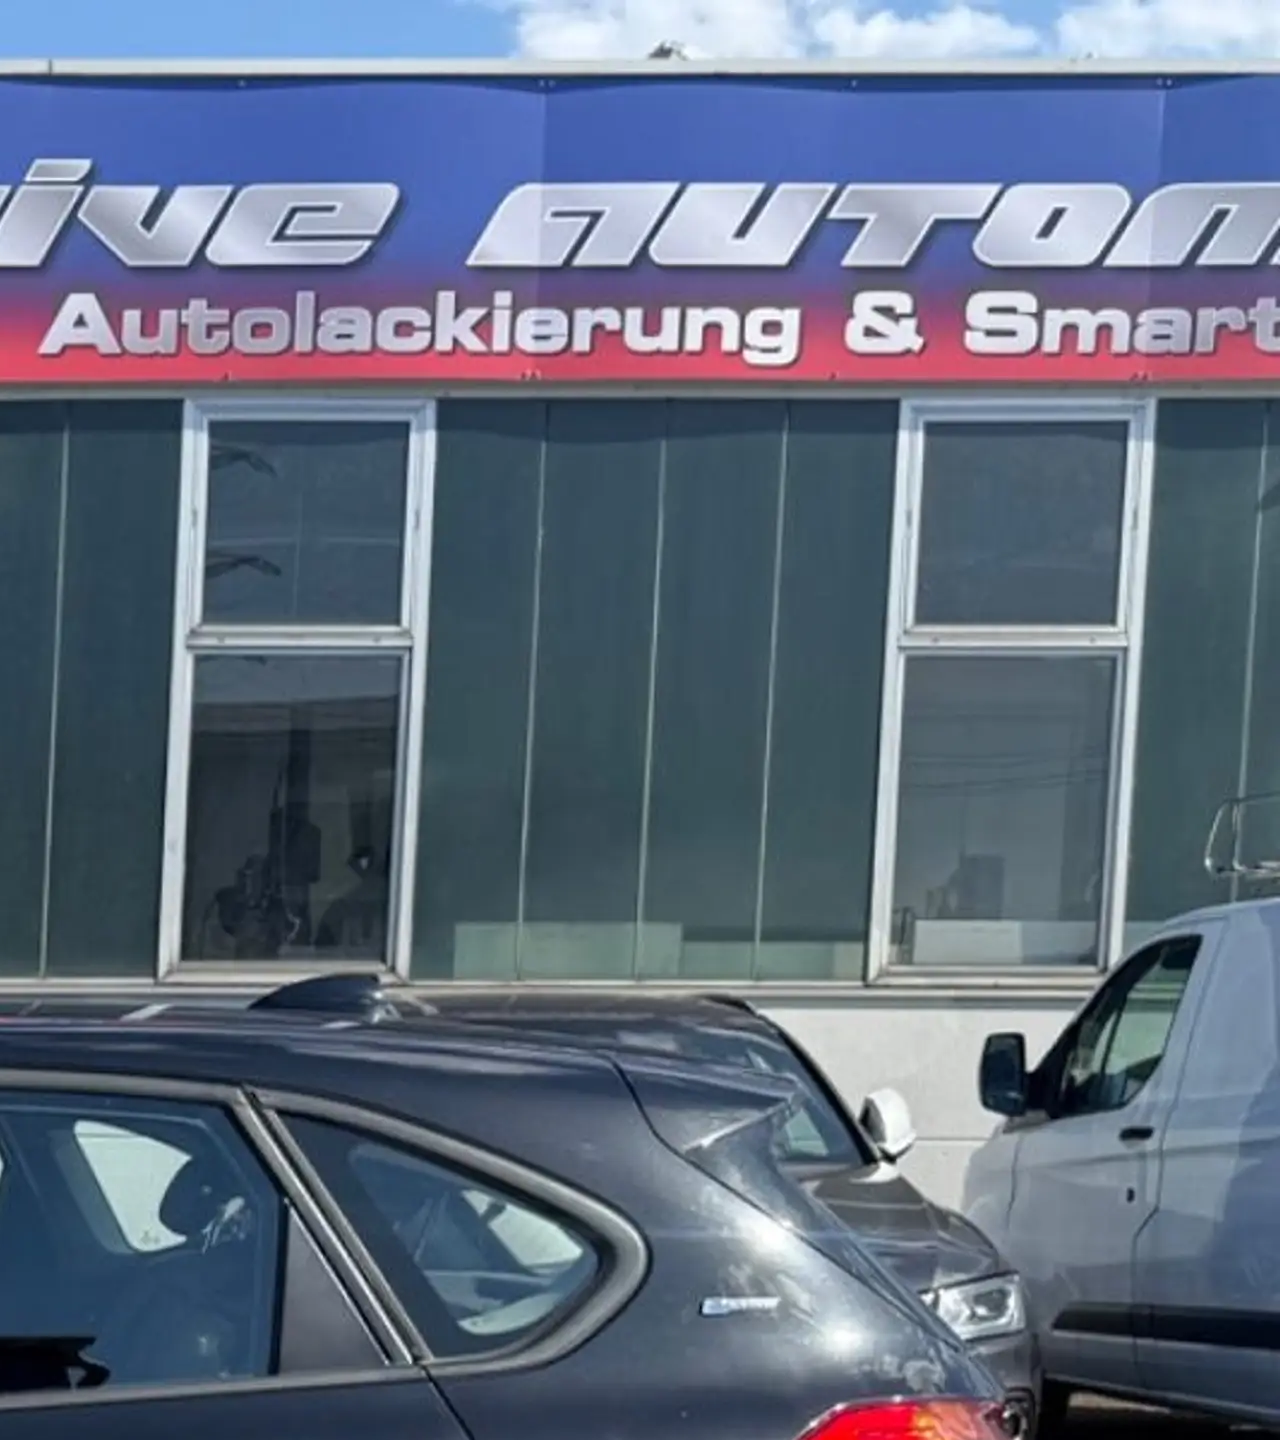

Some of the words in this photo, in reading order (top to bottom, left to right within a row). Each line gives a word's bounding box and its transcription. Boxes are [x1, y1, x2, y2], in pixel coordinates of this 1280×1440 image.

[37, 289, 803, 367] Autolackierung
[844, 289, 925, 356] &
[963, 288, 1280, 357] Smart
